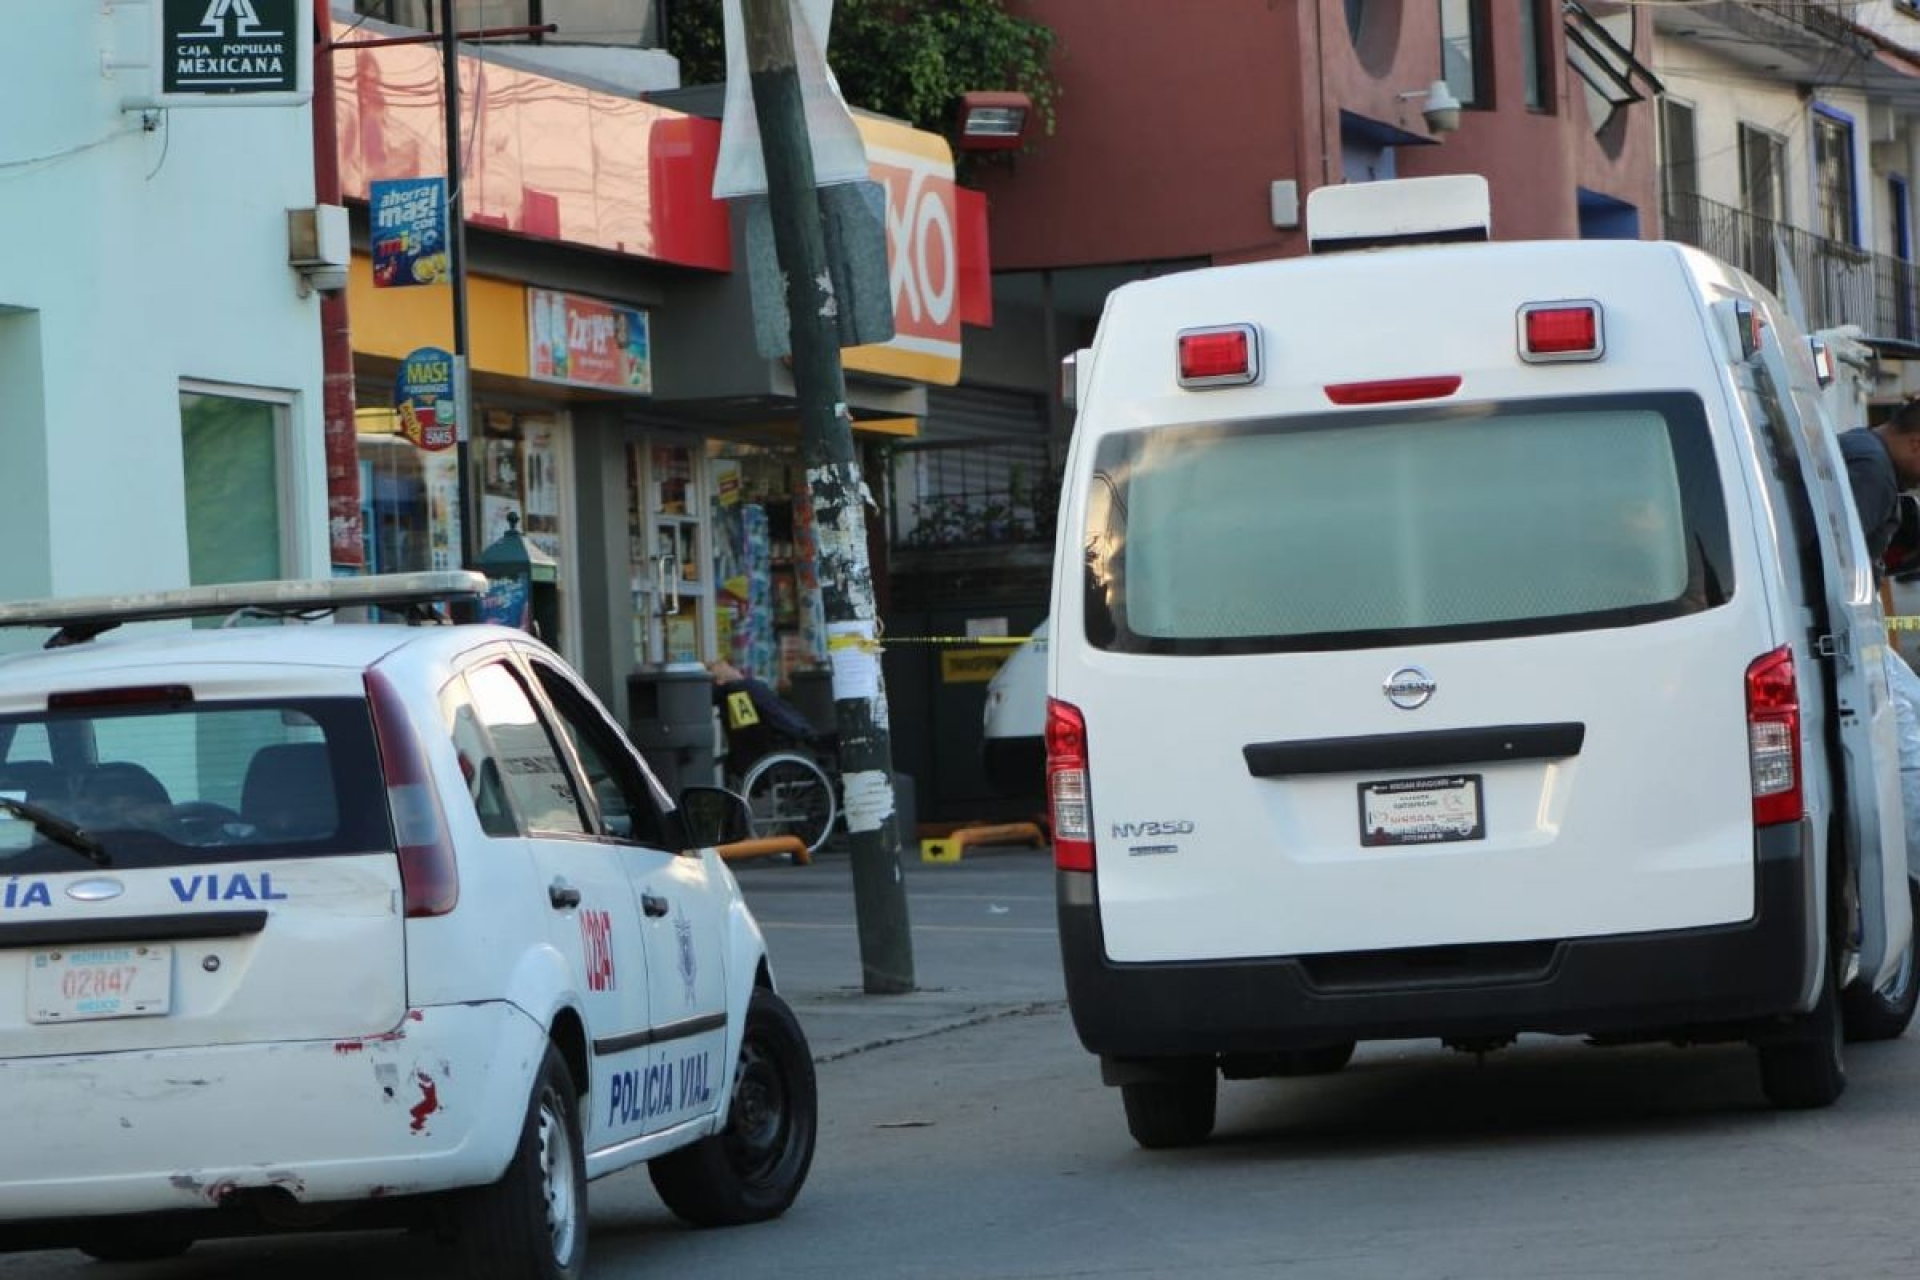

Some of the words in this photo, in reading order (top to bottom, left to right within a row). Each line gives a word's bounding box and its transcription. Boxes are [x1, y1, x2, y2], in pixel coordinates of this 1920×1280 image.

[178, 45, 211, 57] CAJA
[223, 44, 283, 54] POPULAR
[178, 58, 283, 73] MEXICANA
[381, 186, 430, 207] ahorra
[885, 168, 955, 325] XO
[738, 698, 753, 719] A
[3, 876, 51, 908] ÍA
[170, 872, 288, 902] VIAL
[62, 966, 138, 999] 02847
[608, 1051, 673, 1127] POLICÍA
[679, 1050, 710, 1110] VIAL
